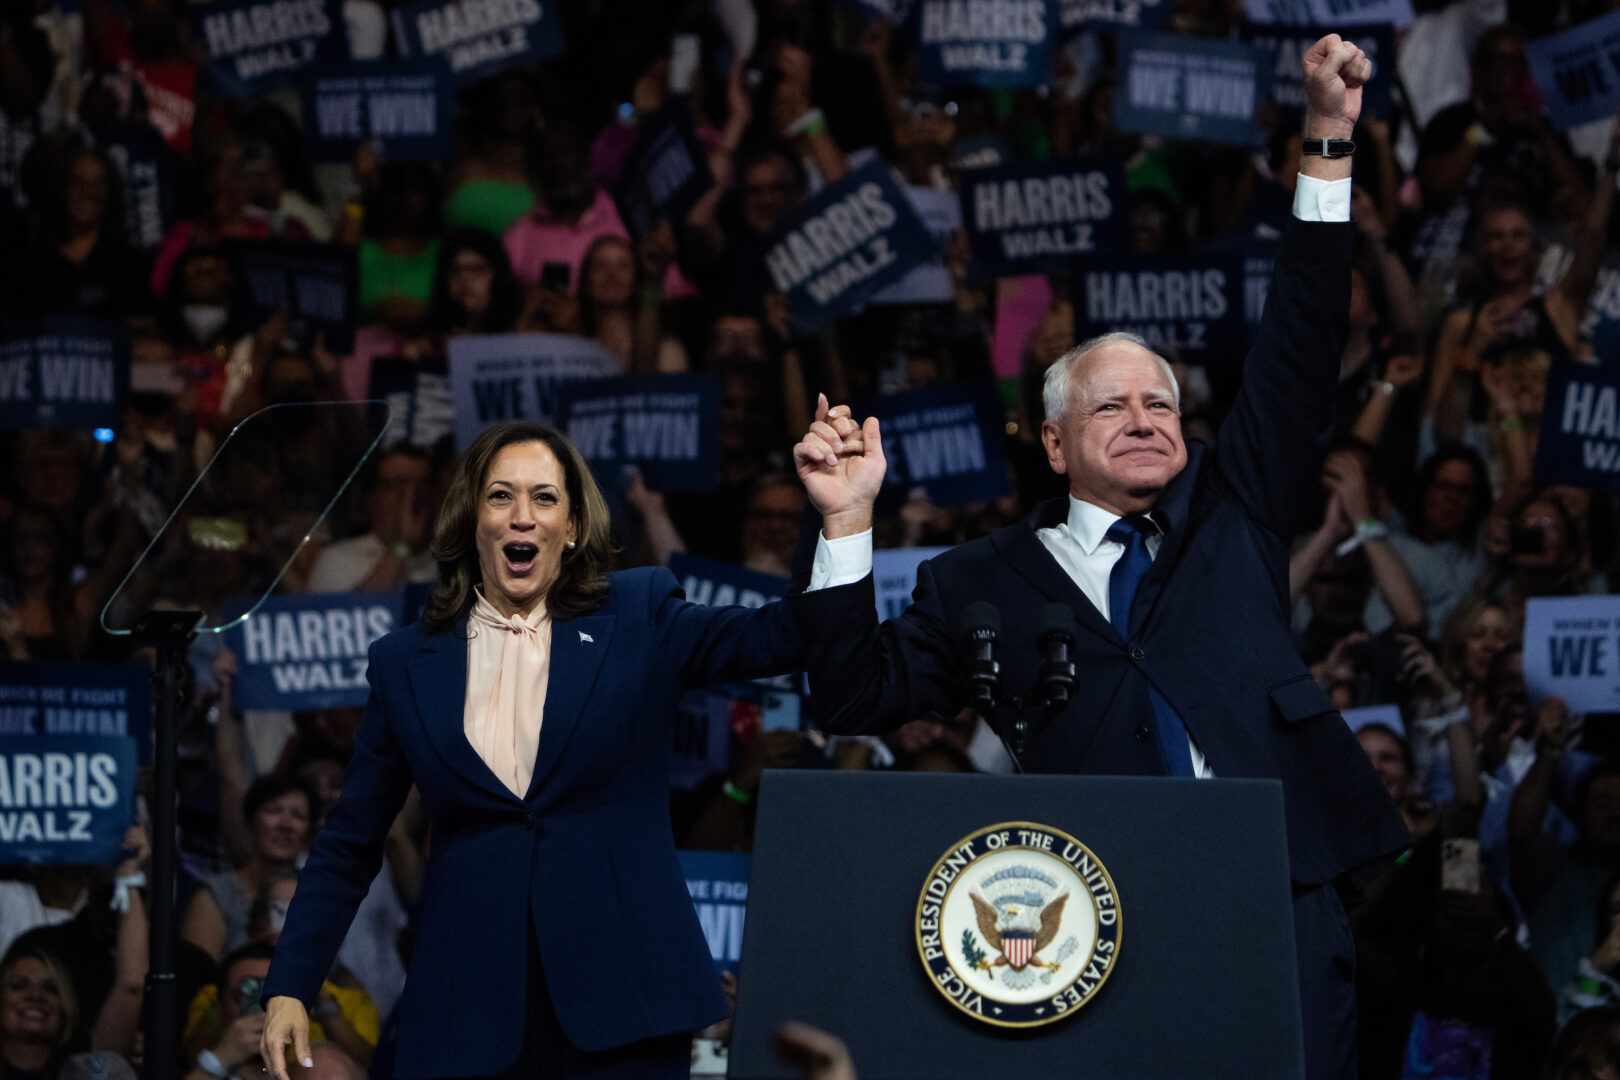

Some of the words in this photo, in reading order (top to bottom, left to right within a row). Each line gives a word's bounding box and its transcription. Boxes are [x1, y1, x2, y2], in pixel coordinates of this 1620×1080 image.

[203, 0, 331, 57] HARRIS
[416, 0, 543, 56] HARRIS
[920, 0, 1048, 44] HARRIS
[234, 40, 316, 79] WALZ
[451, 26, 530, 72] WALZ
[941, 43, 1027, 71] WALZ
[973, 170, 1113, 232] HARRIS
[764, 181, 898, 295] HARRIS
[1001, 222, 1097, 260] WALZ
[806, 236, 898, 307] WALZ
[1085, 268, 1228, 322] HARRIS
[39, 354, 114, 402] WIN
[473, 377, 524, 421] WE
[623, 410, 698, 460] WIN
[243, 605, 393, 665] HARRIS
[1550, 635, 1607, 676] WE
[271, 661, 370, 693] WALZ
[986, 831, 1010, 850] OF
[1018, 831, 1054, 851] THE
[921, 842, 976, 961] PRESIDENT
[1062, 842, 1117, 926] UNITED
[937, 967, 984, 1015] VICE
[1052, 938, 1115, 1013] STATES
